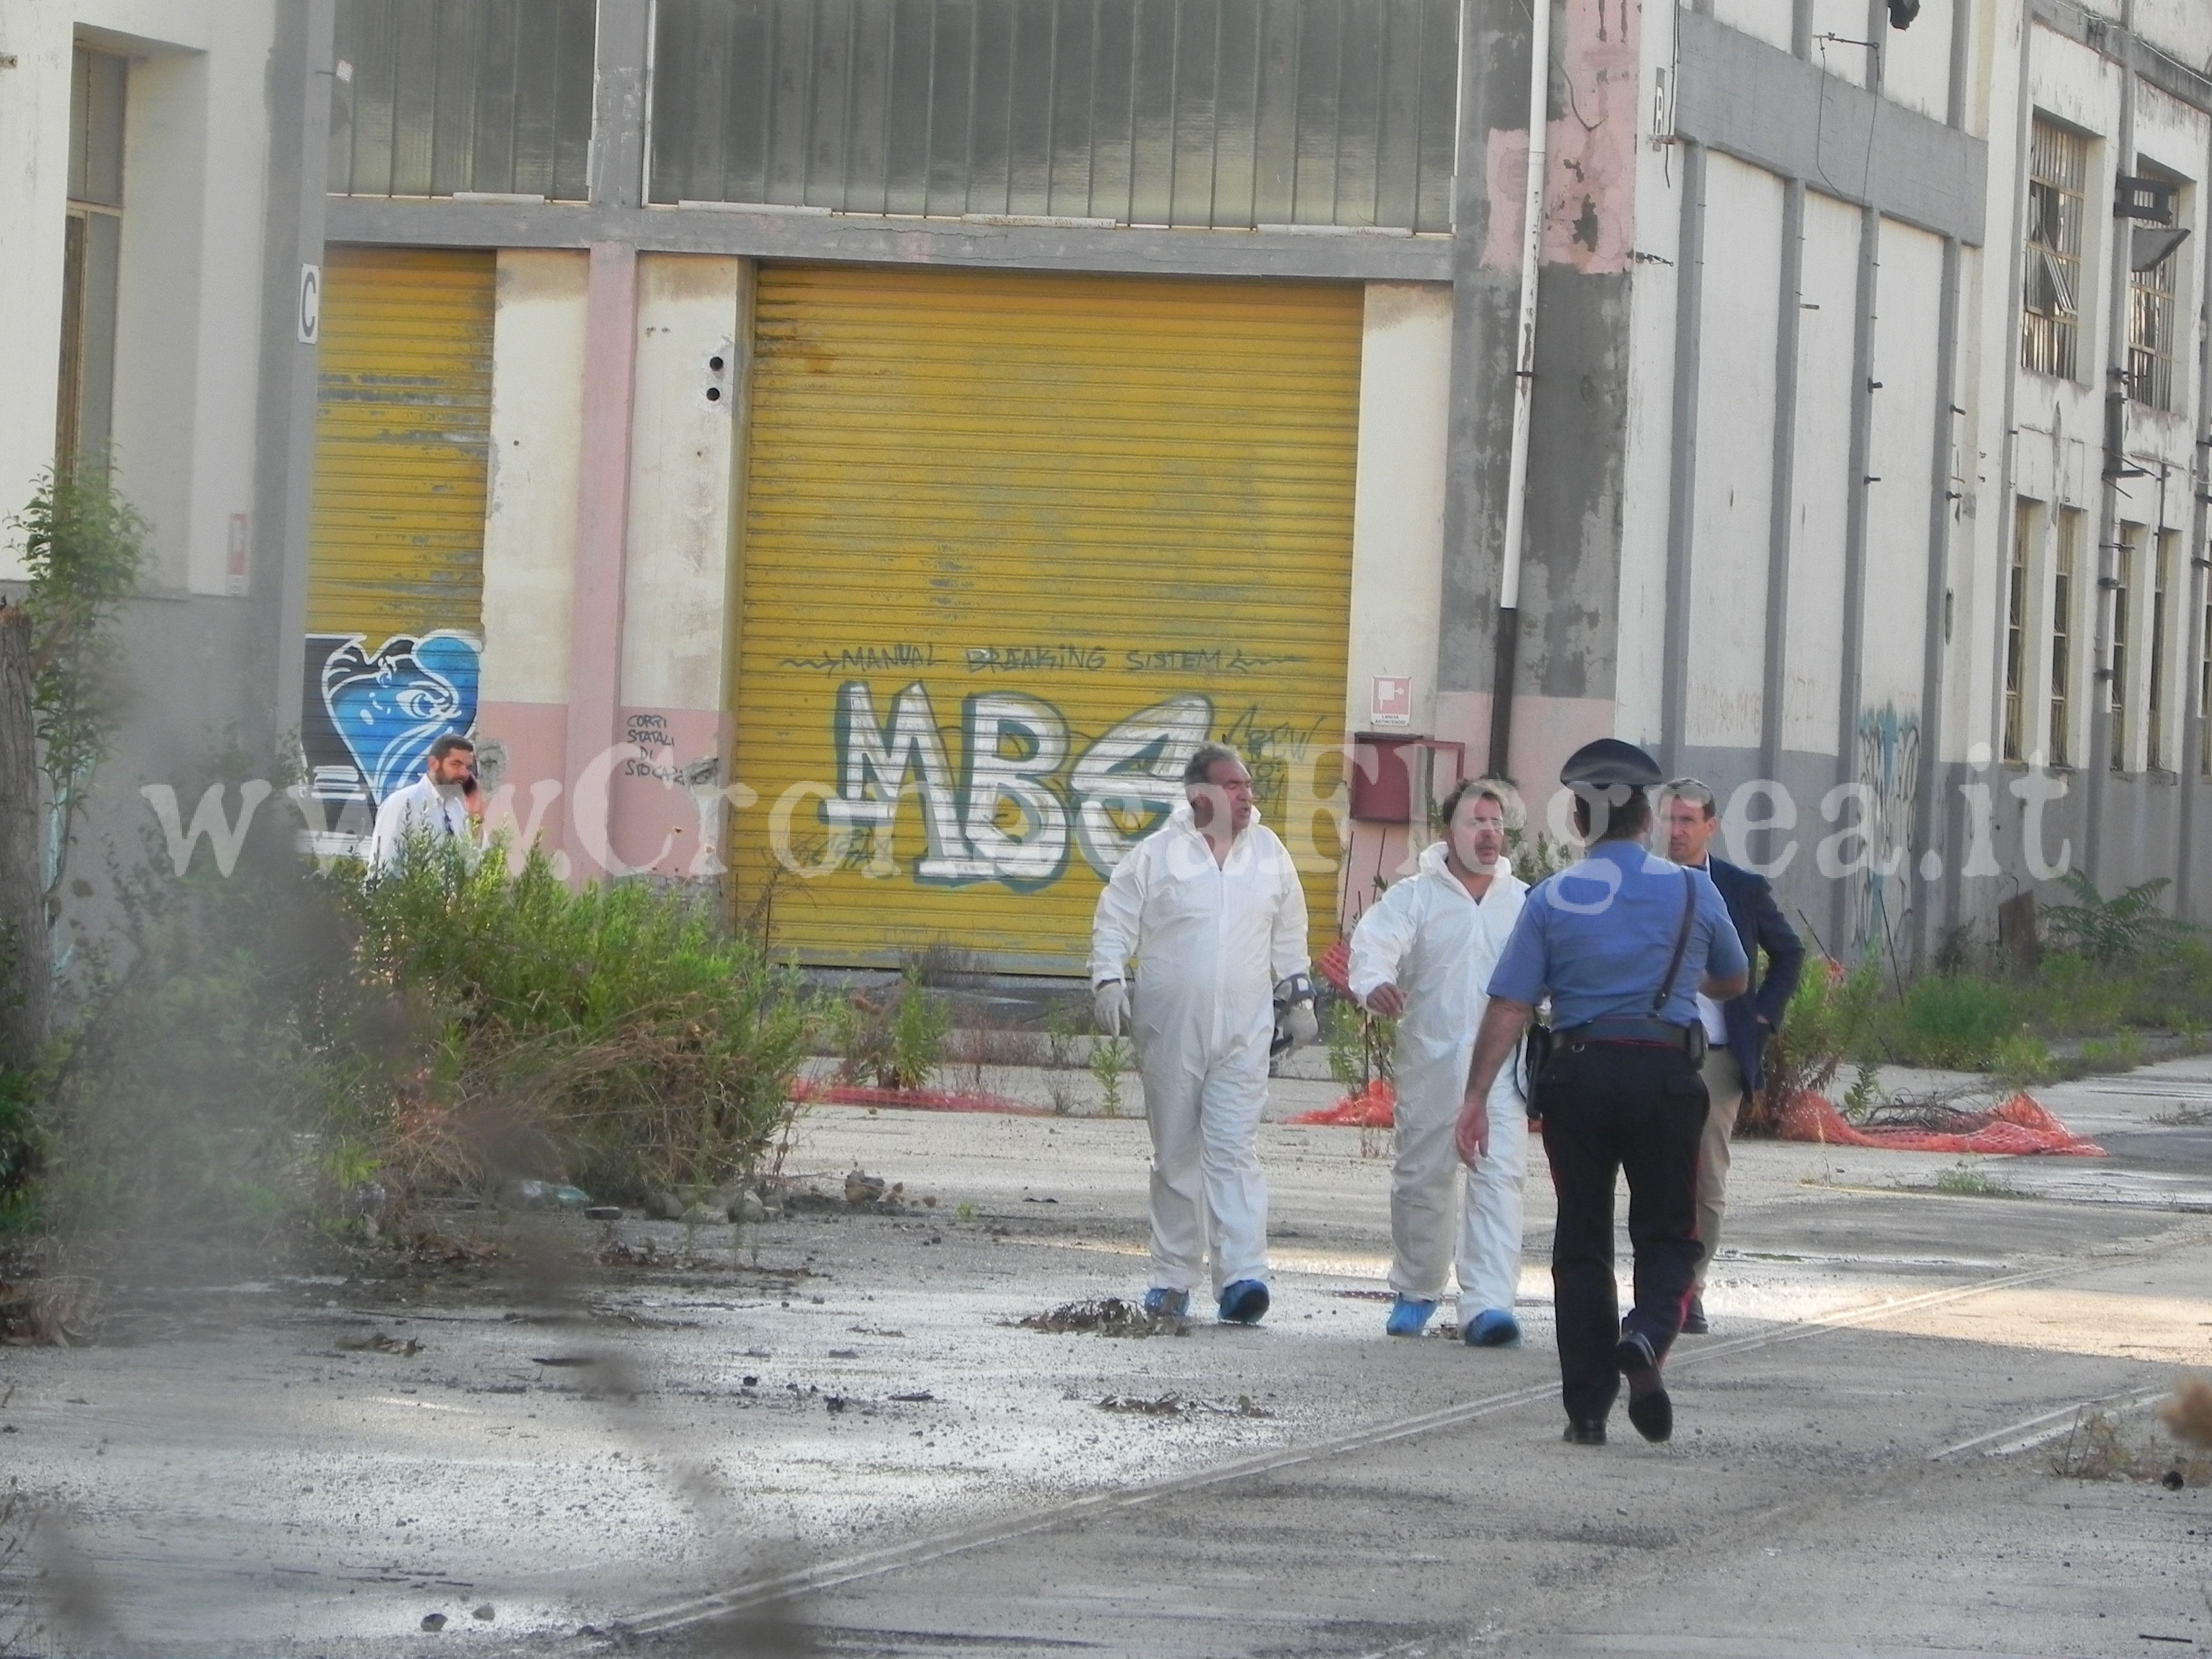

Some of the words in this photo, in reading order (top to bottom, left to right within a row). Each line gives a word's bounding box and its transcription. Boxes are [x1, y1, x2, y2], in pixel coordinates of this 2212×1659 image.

[302, 271, 316, 337] C
[841, 642, 947, 672] MANUAL
[1125, 648, 1223, 671] SISTEM
[640, 746, 653, 760] DI
